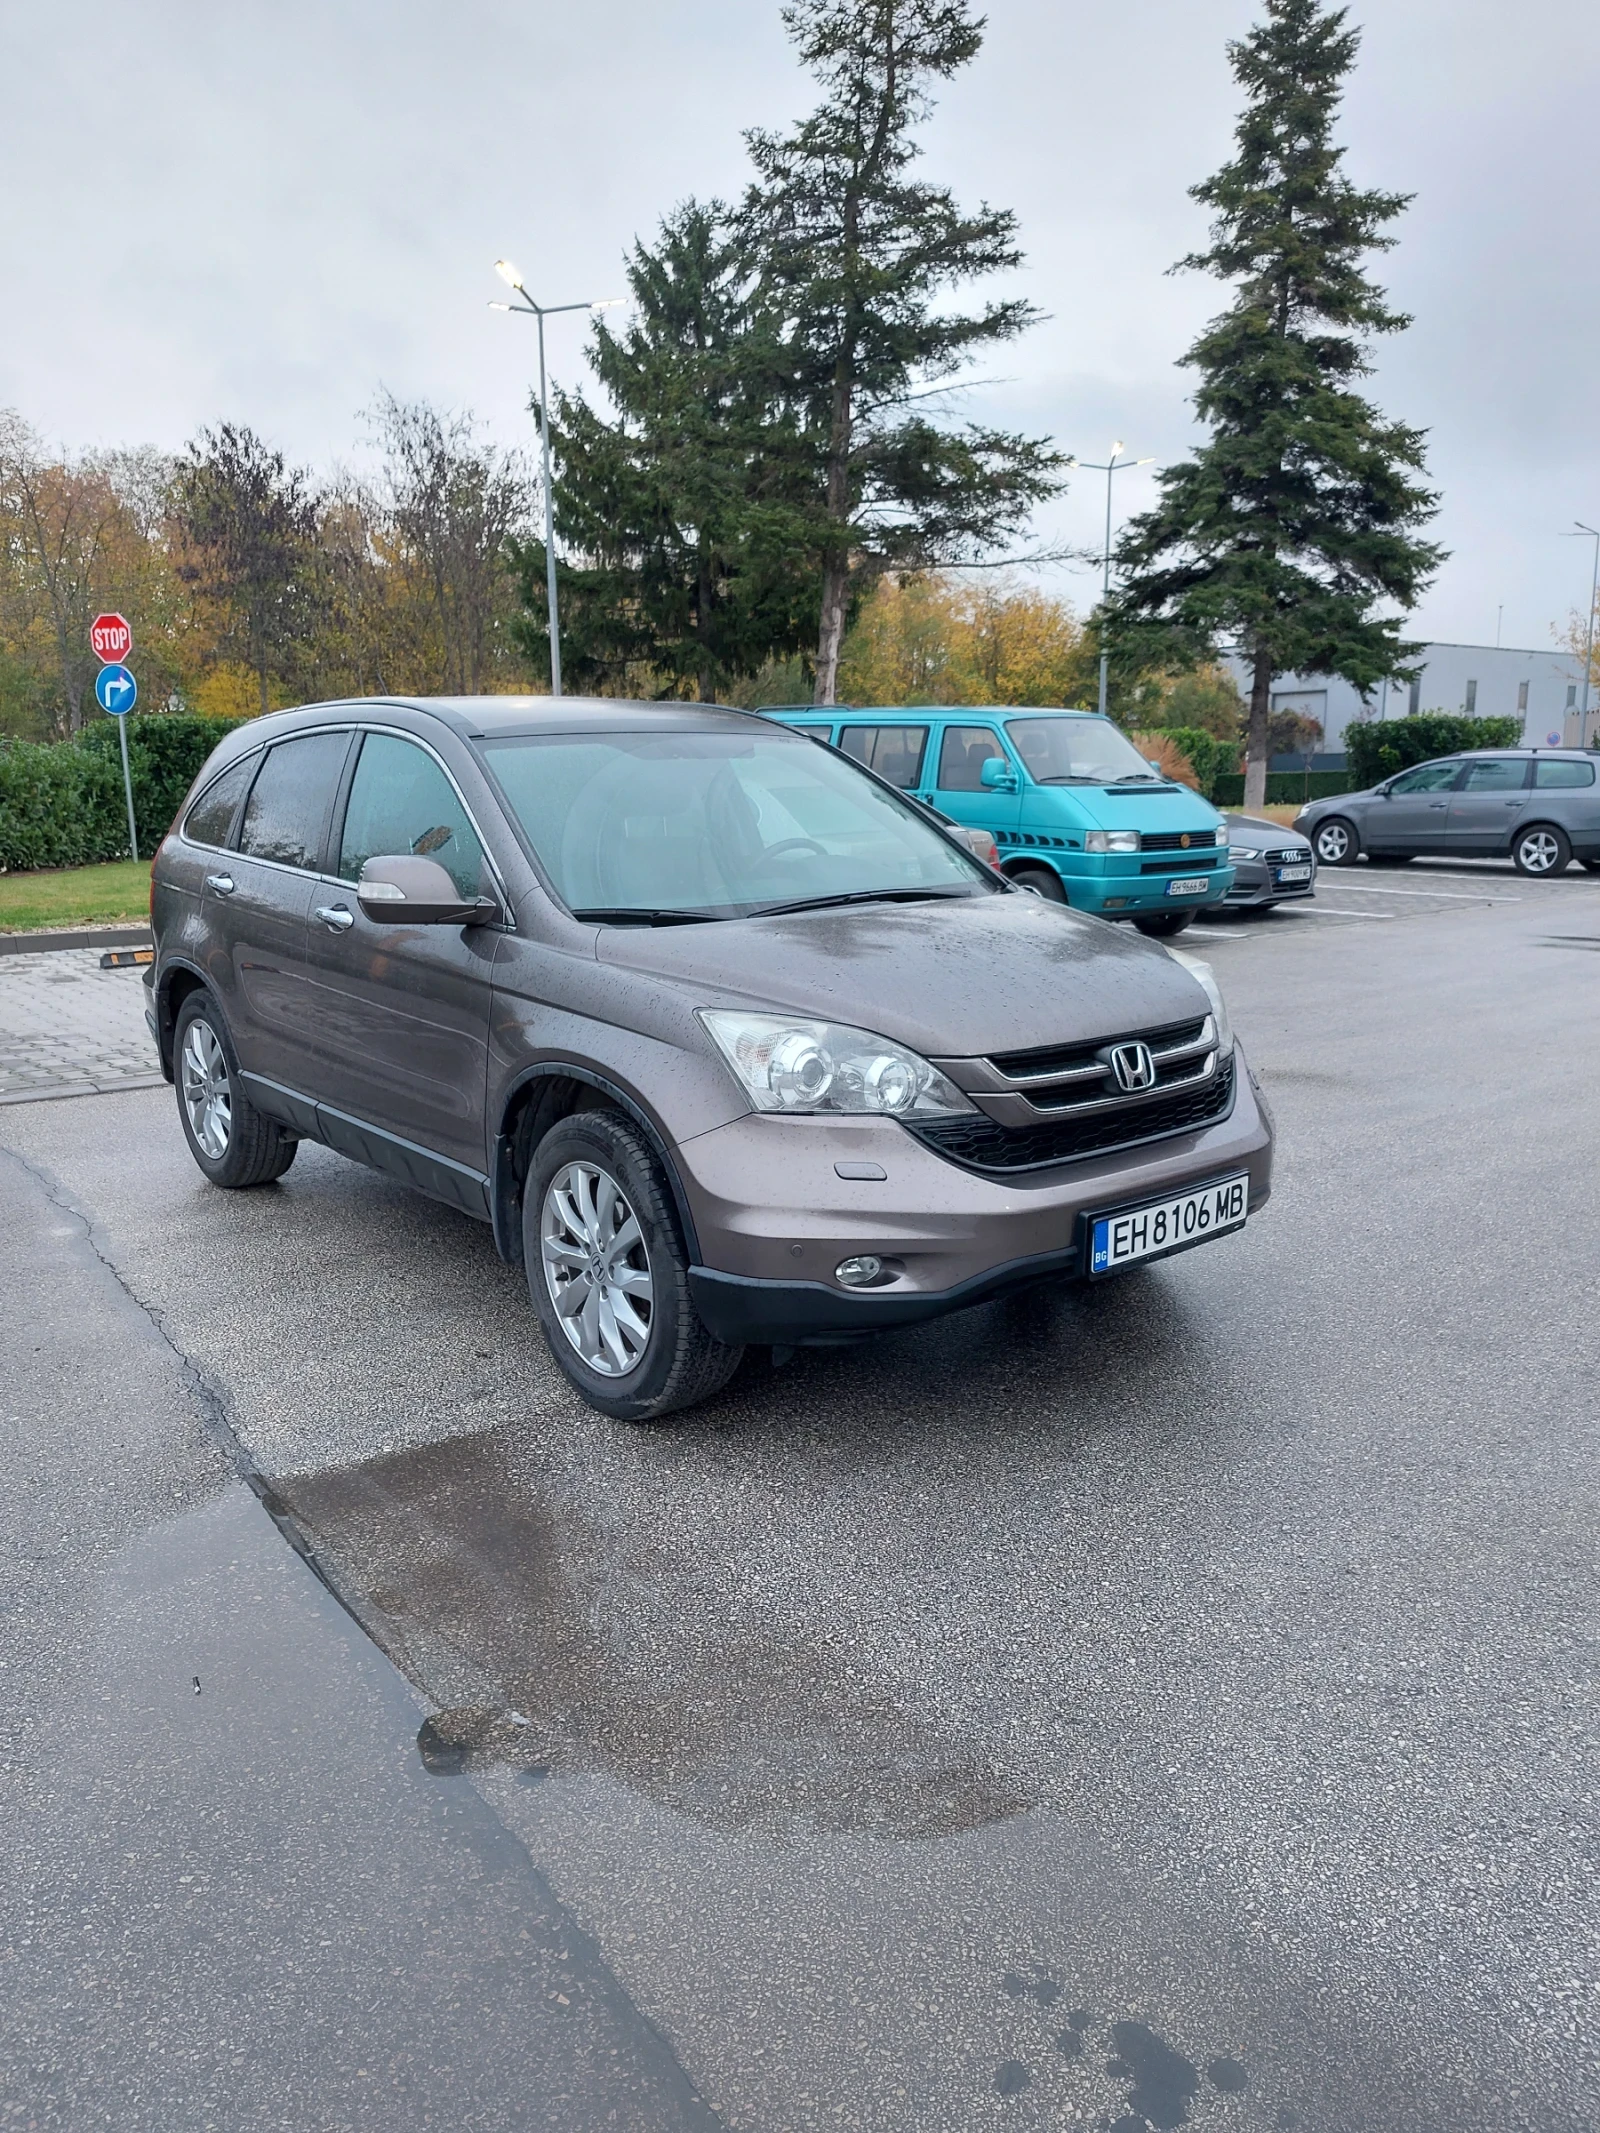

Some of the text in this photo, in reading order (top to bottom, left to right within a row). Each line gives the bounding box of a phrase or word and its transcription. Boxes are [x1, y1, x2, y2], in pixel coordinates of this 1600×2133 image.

[94, 627, 127, 650] STOP
[1171, 882, 1181, 893] EH
[1181, 881, 1197, 892] 9666
[1113, 1183, 1243, 1259] EH 8106 MB
[1095, 1250, 1107, 1263] BG
